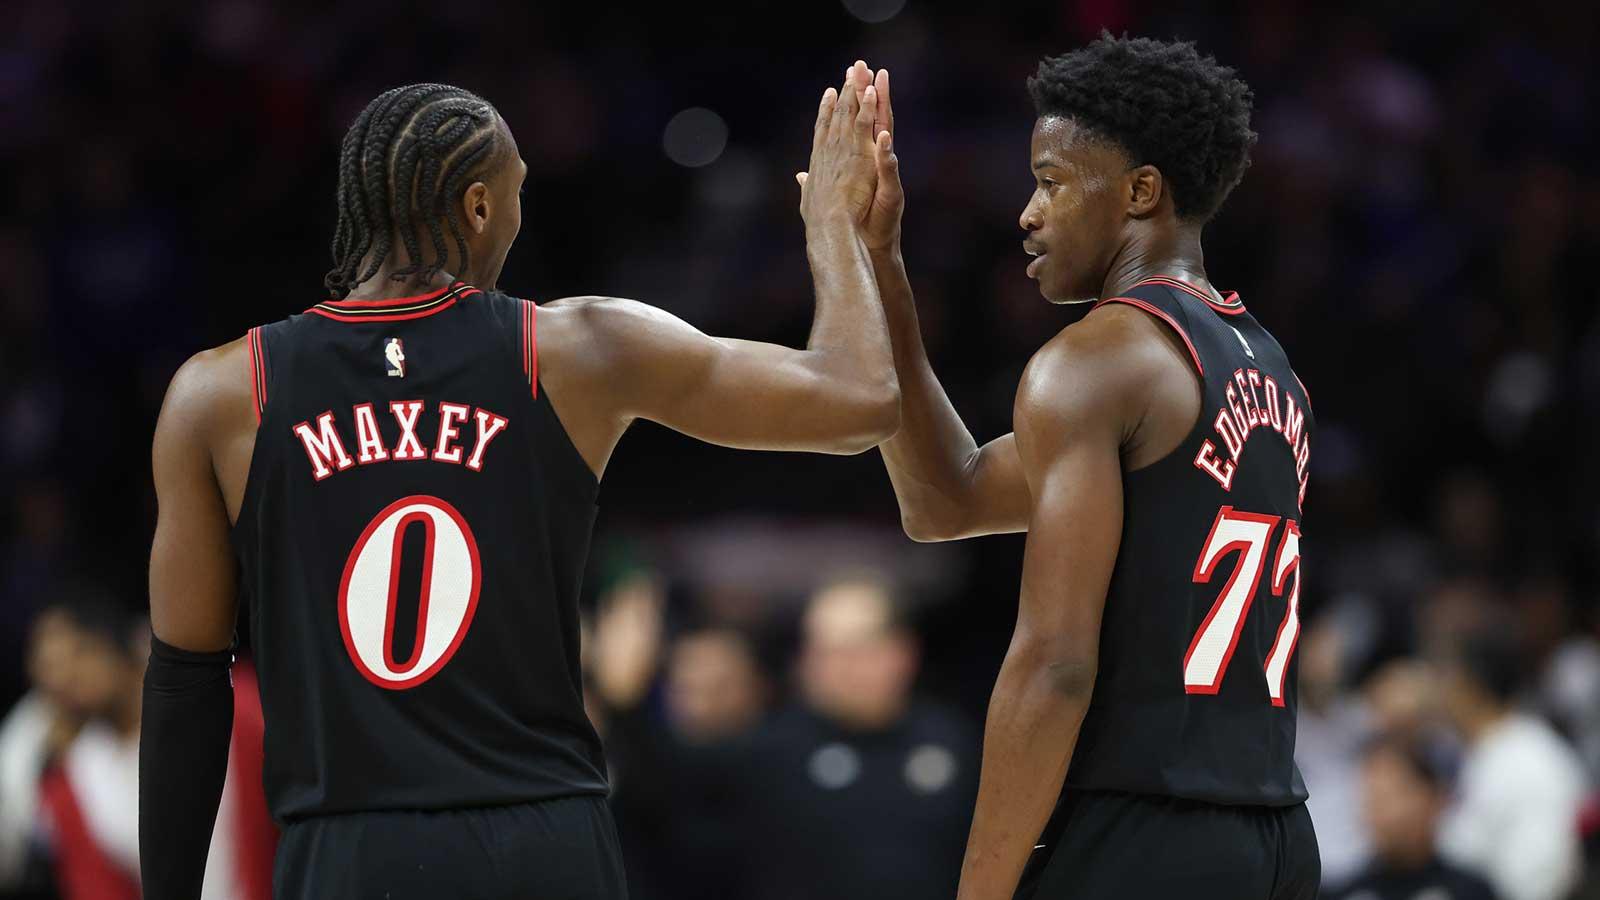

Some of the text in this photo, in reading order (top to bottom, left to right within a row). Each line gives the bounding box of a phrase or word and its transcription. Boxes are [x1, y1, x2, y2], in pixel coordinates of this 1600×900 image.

[293, 400, 509, 481] MAXEY
[1193, 368, 1309, 516] EDGECOMB
[337, 494, 482, 690] 0
[1183, 505, 1302, 707] 77
